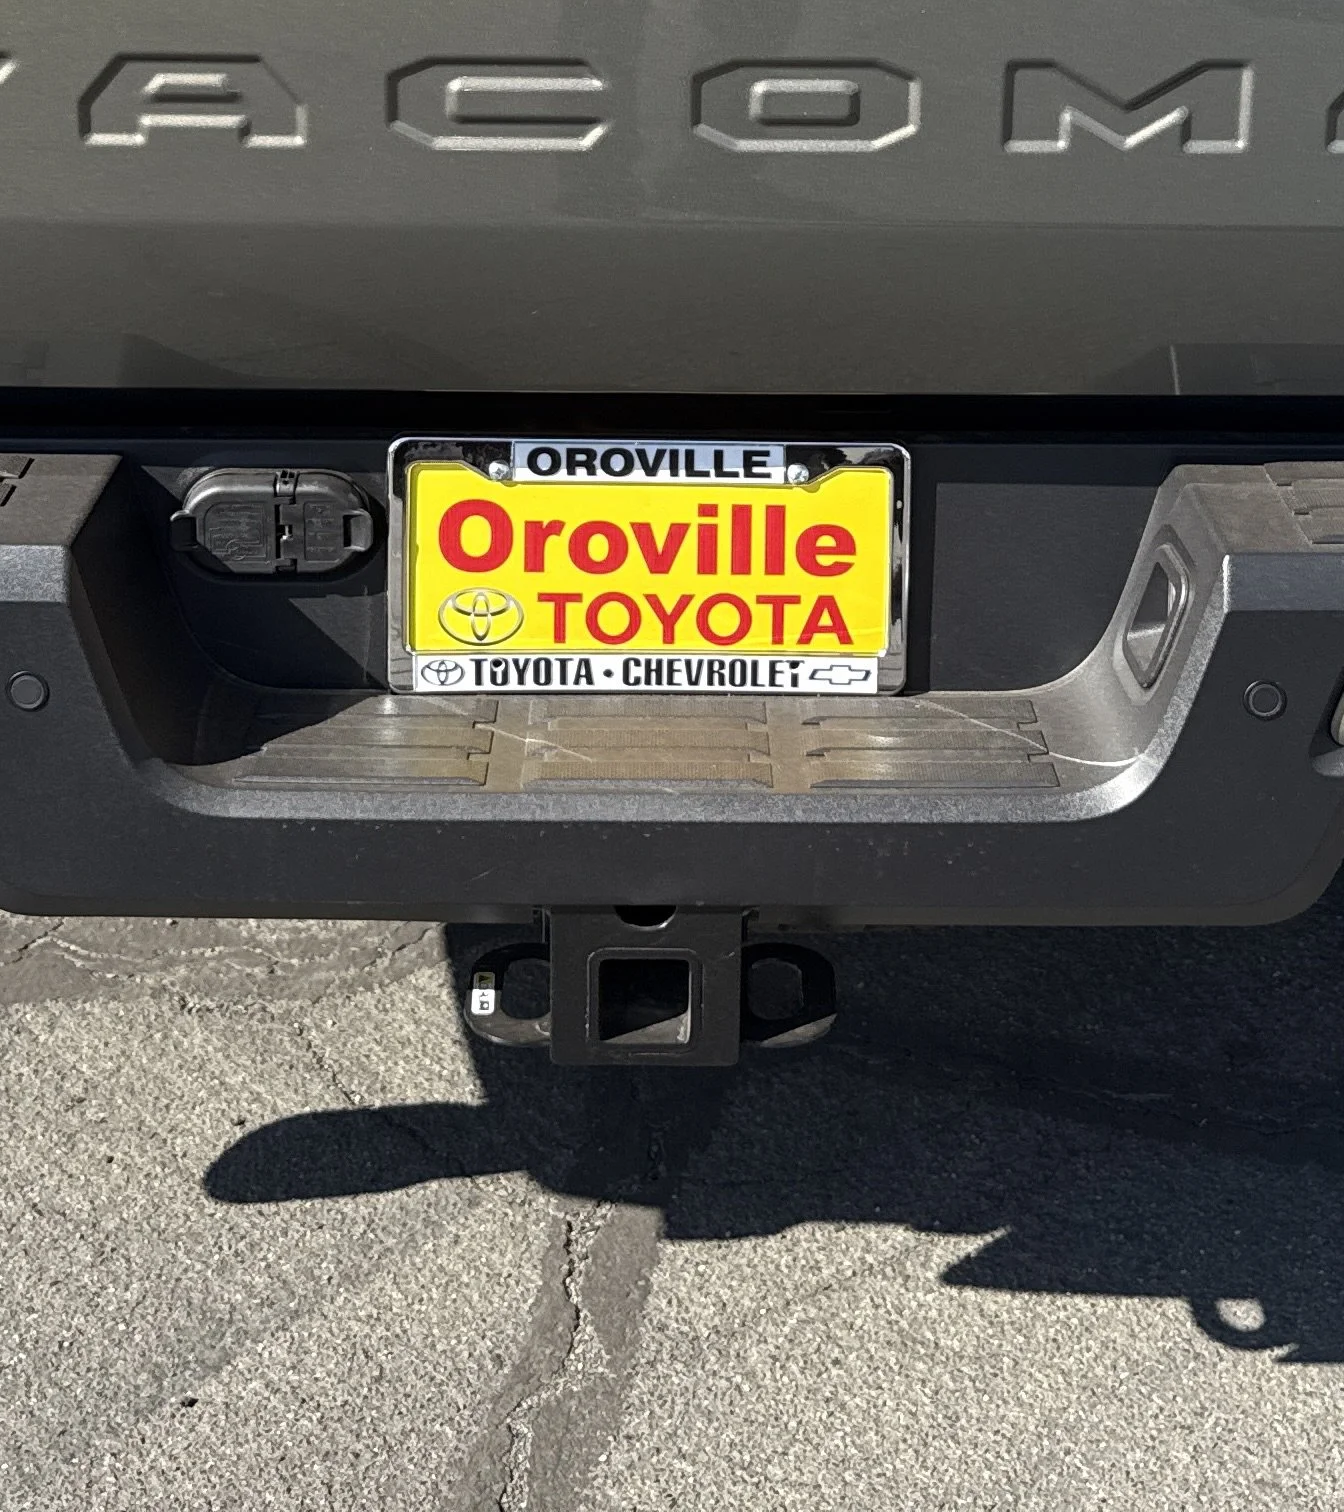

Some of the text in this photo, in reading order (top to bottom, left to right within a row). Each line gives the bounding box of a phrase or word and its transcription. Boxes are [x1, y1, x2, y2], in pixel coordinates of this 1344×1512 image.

[526, 446, 773, 478] OROVILLE
[438, 498, 857, 577] Oroville
[537, 591, 854, 646] TOYOTA
[469, 656, 805, 688] TOYOTA CHEVROLET
